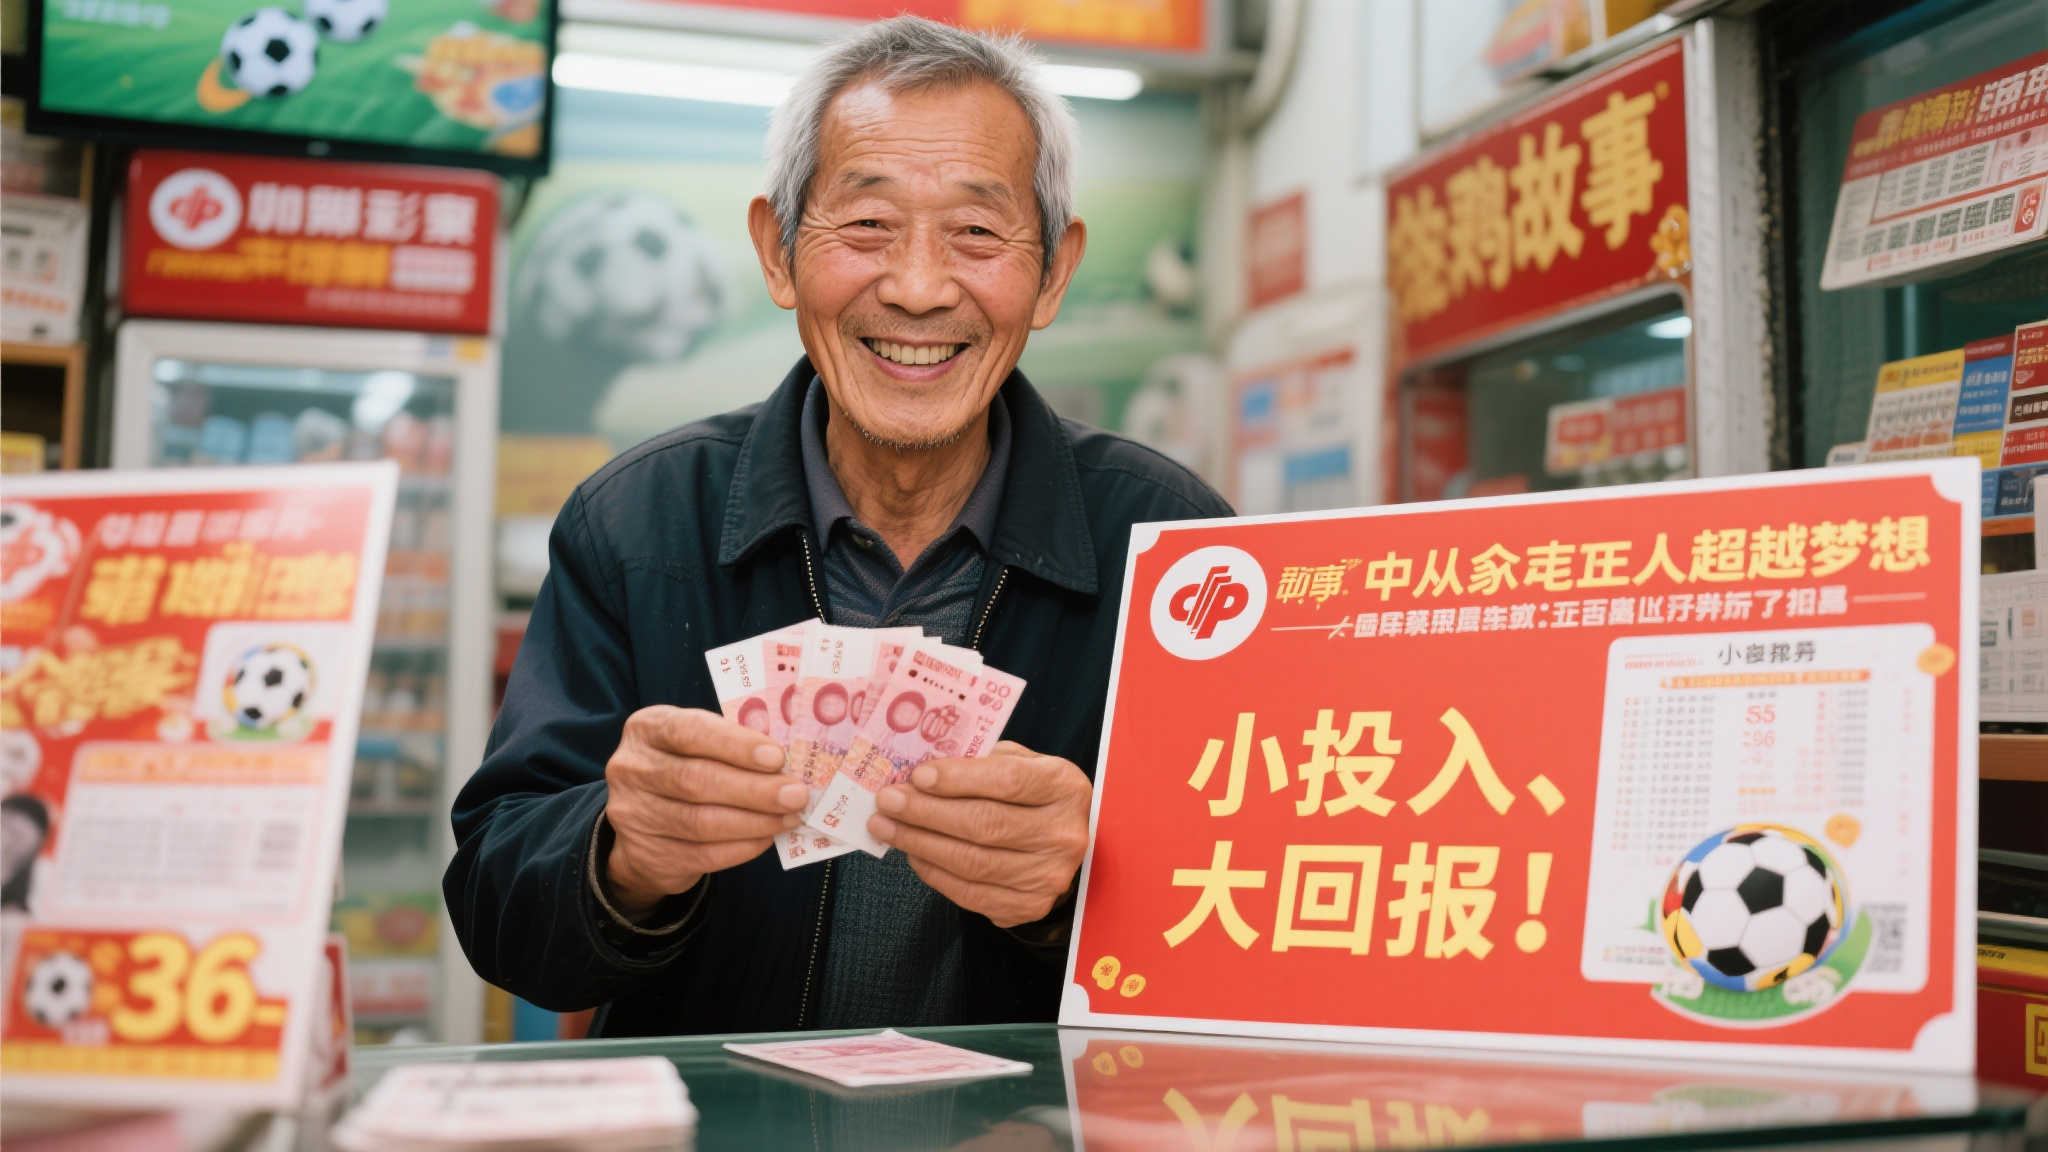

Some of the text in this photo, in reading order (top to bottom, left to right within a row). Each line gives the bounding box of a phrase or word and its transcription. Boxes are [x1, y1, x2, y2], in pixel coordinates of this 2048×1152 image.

[1187, 707, 1566, 817] 小投入、
[1162, 840, 1553, 960] 大回报！
